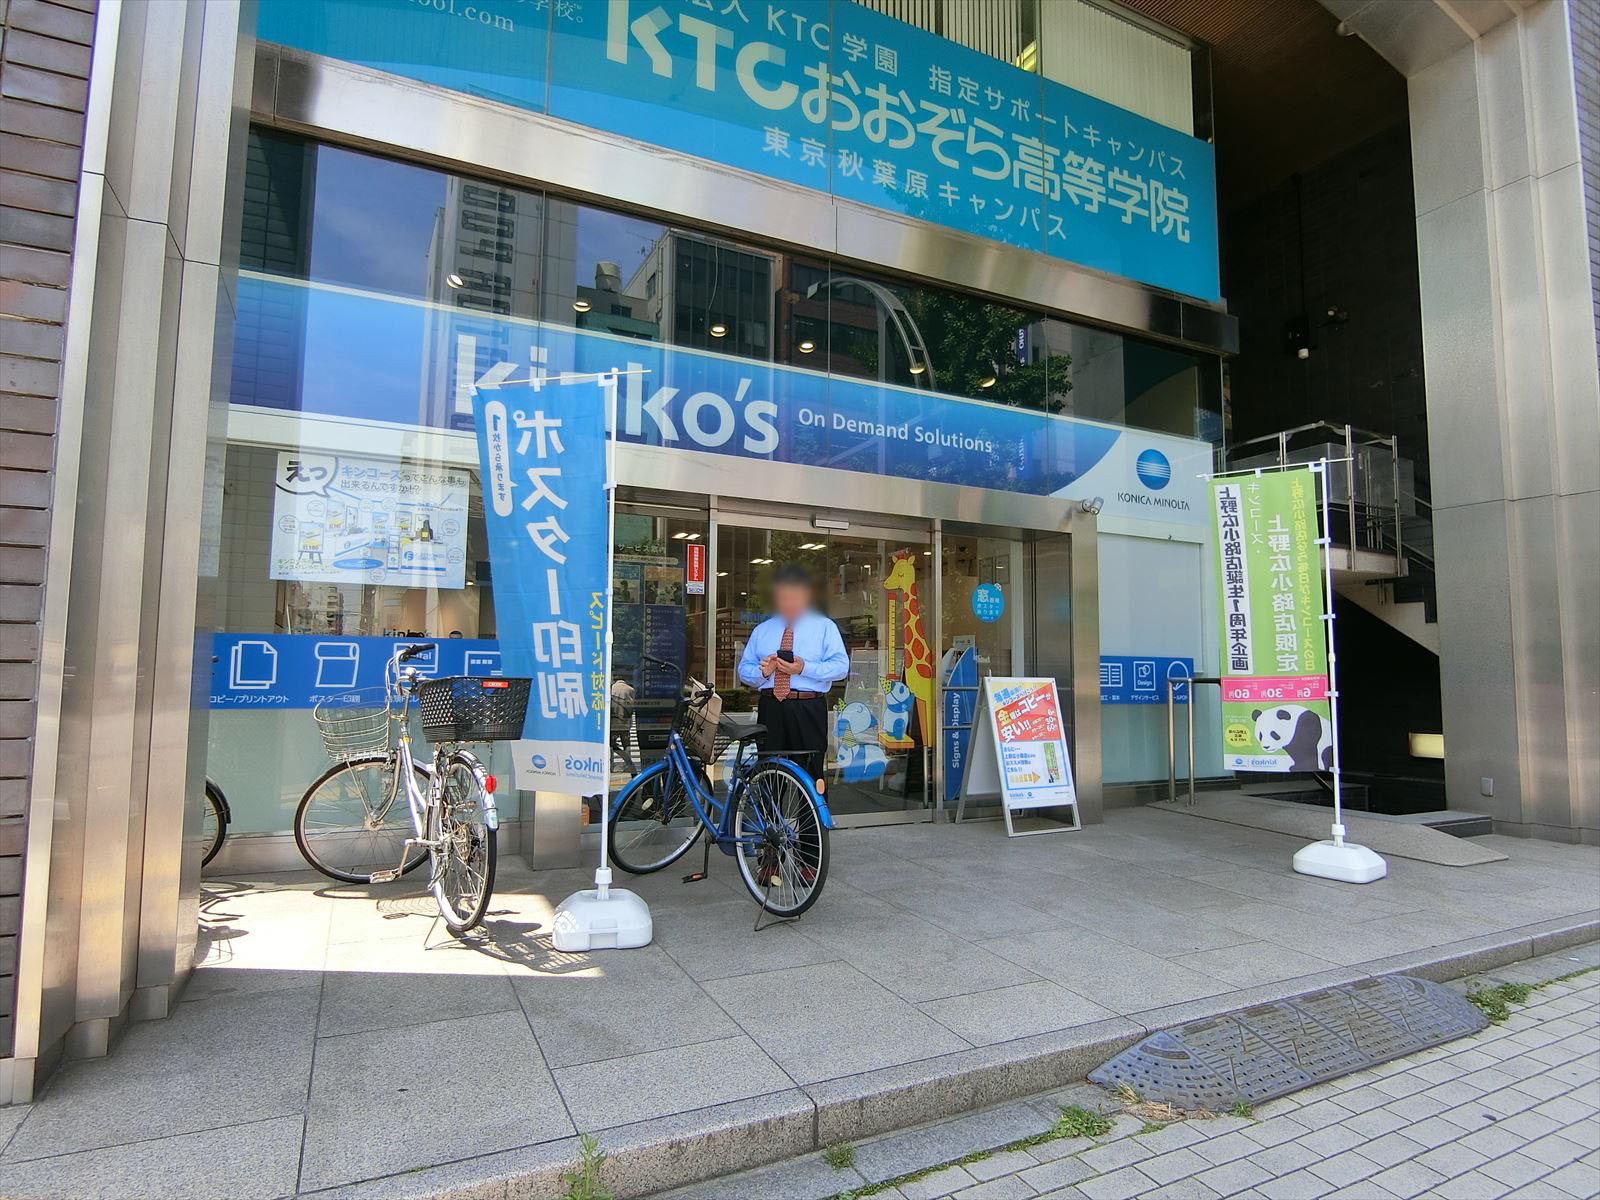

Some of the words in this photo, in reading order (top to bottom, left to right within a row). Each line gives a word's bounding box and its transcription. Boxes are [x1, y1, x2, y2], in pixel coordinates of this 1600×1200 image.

[929, 63, 1187, 181] 指定サポートキャンパス
[762, 125, 1067, 240] 東京秋葉原キャンパス
[455, 334, 780, 454] kiko's
[798, 407, 826, 428] On
[833, 413, 909, 441] Demand
[914, 426, 993, 454] Solutions
[285, 460, 328, 484] えっ
[1117, 492, 1151, 506] KONICA
[1153, 497, 1191, 512] MINOLTA
[951, 731, 961, 740] &
[952, 740, 961, 768] Signs
